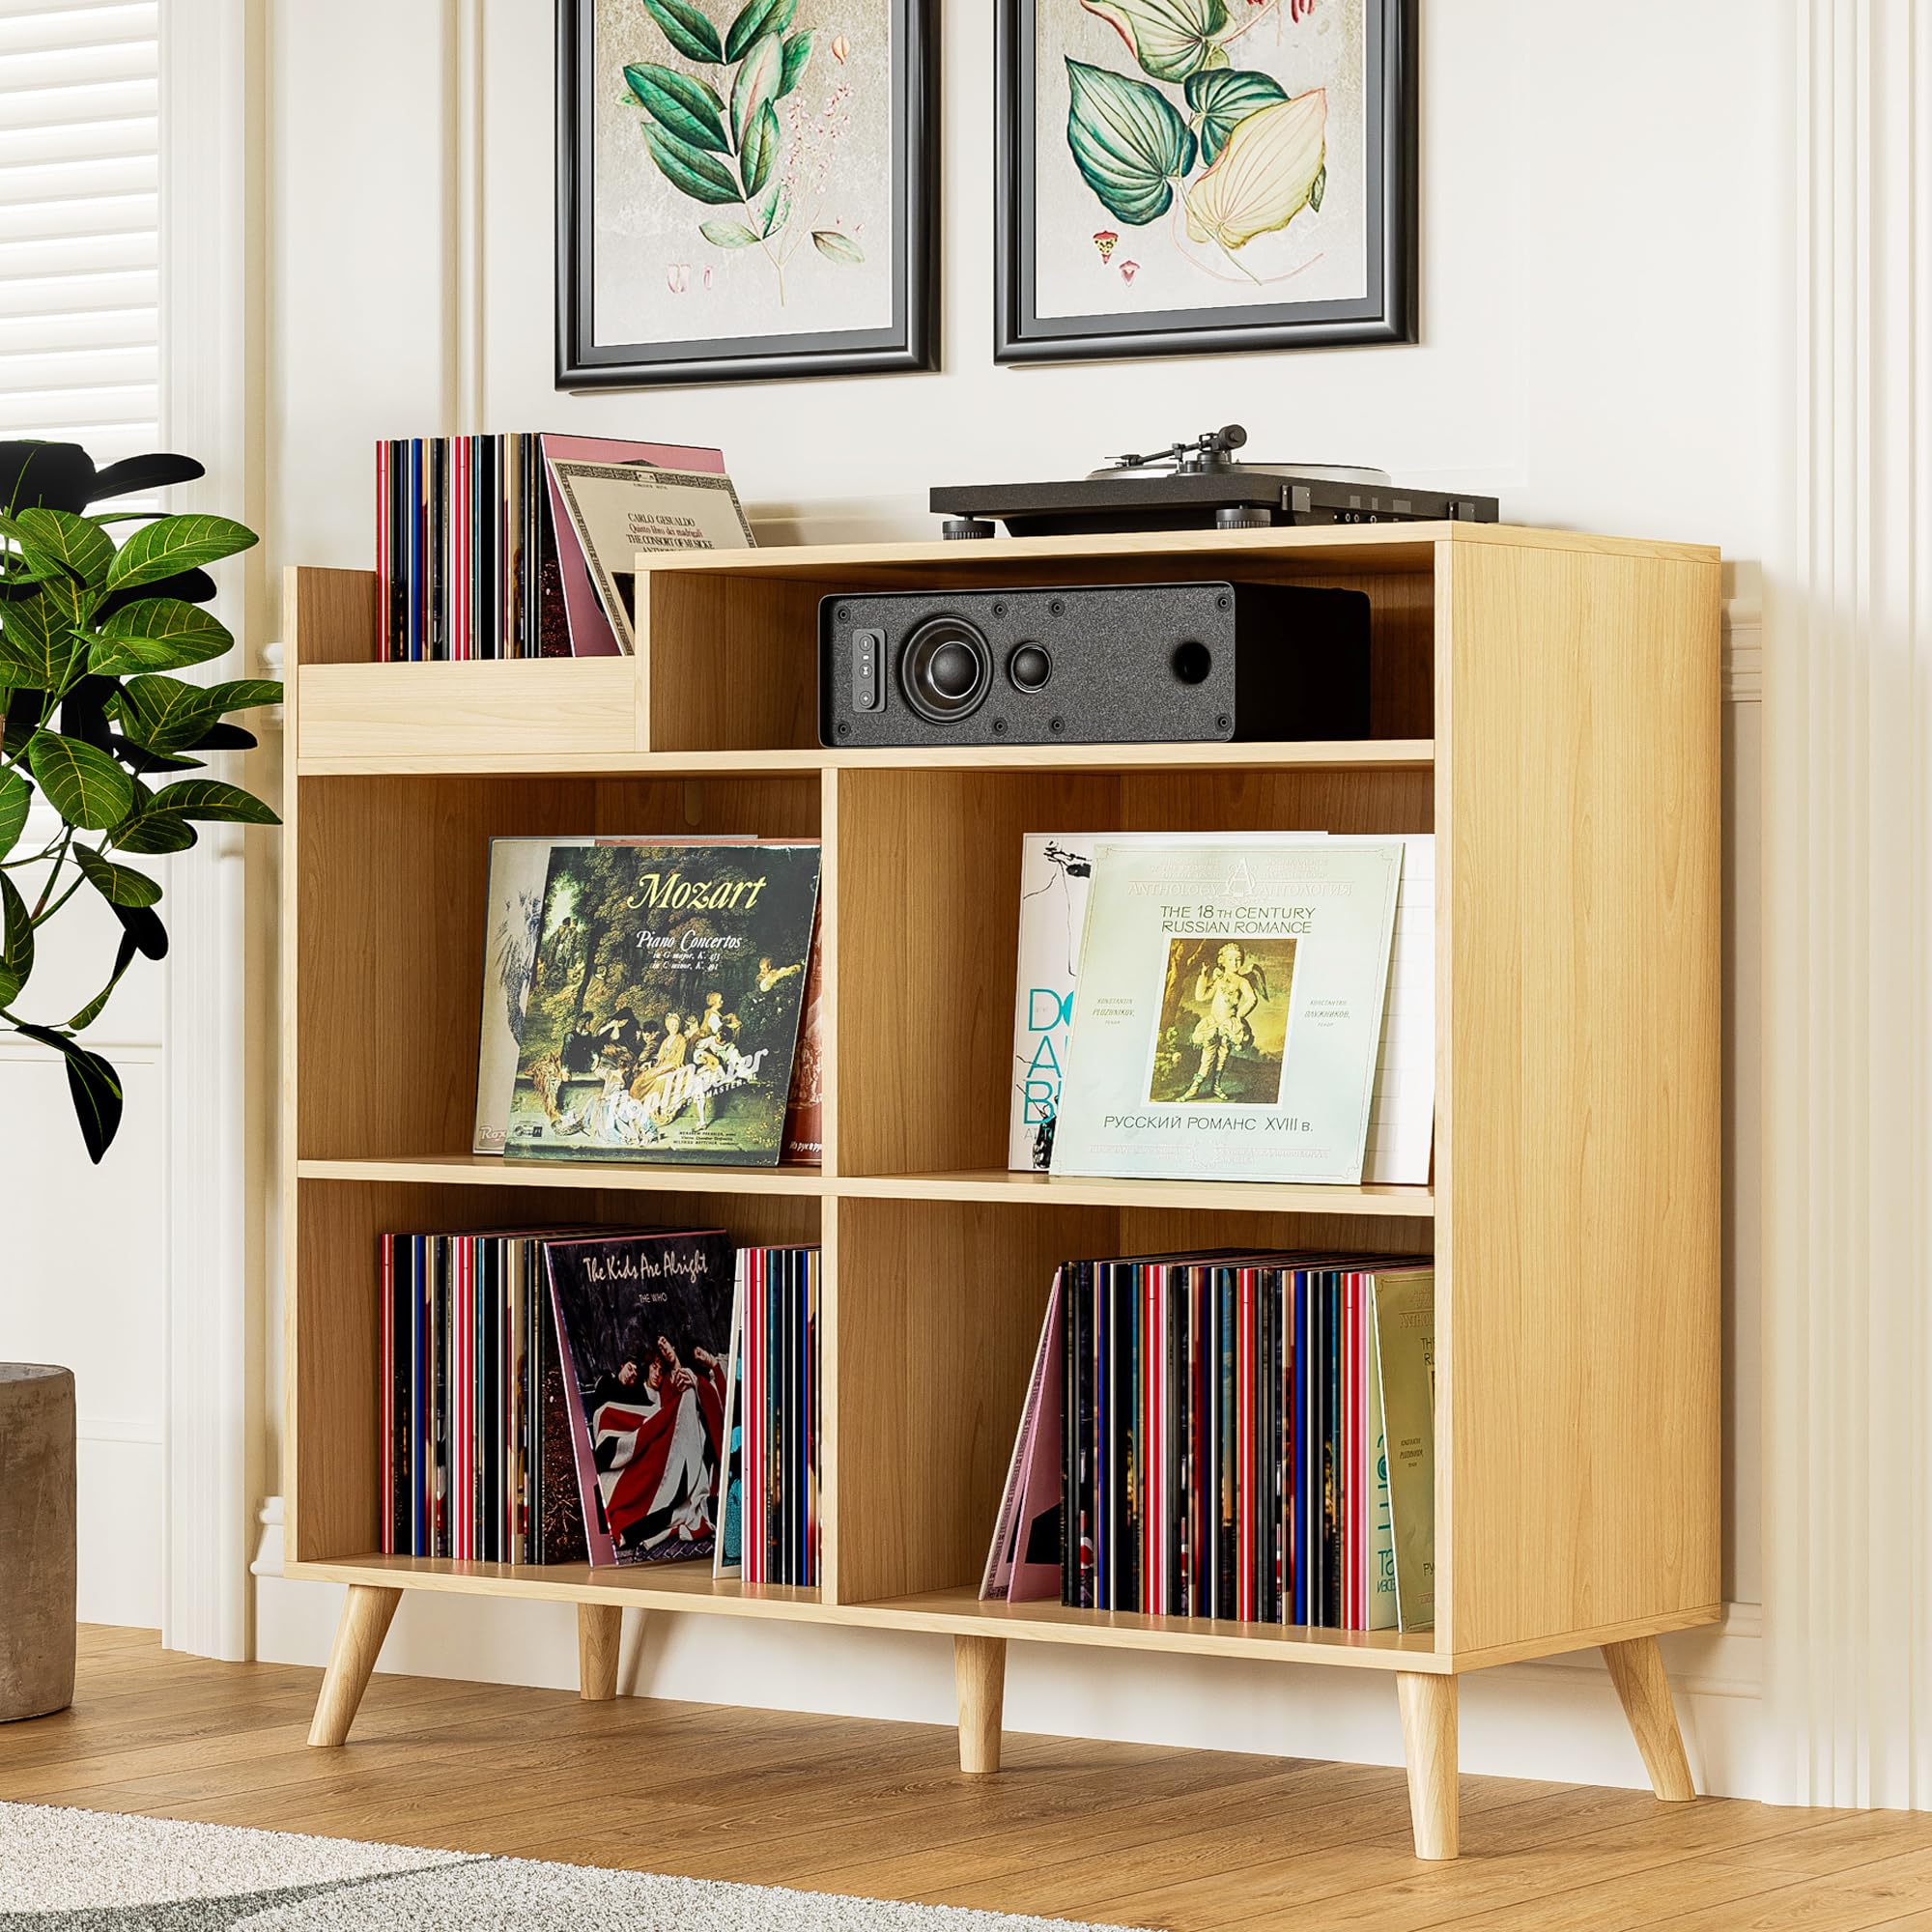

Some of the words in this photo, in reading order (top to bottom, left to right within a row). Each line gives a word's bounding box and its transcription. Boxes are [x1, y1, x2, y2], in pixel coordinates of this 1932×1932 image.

[628, 513, 655, 524] CARLO
[626, 533, 642, 544] THE
[642, 535, 673, 547] CONSORT
[673, 538, 683, 547] OF
[626, 872, 767, 910] Mozart
[1160, 905, 1191, 919] THE
[1235, 906, 1317, 920] CENTURY
[1161, 921, 1231, 934] RUSSIAN
[1234, 921, 1313, 934] ROMANCE
[636, 929, 675, 949] Piano
[680, 929, 743, 952] Concertos
[1103, 1115, 1181, 1129] РУССКИЙ
[1187, 1117, 1257, 1131] РОМАНС
[1264, 1118, 1298, 1131] XVIII
[582, 1257, 606, 1282] The
[607, 1255, 639, 1280] Kids
[639, 1252, 662, 1280] Are
[664, 1249, 708, 1284] Alright
[639, 1293, 651, 1303] THE
[652, 1292, 668, 1302] WHO
